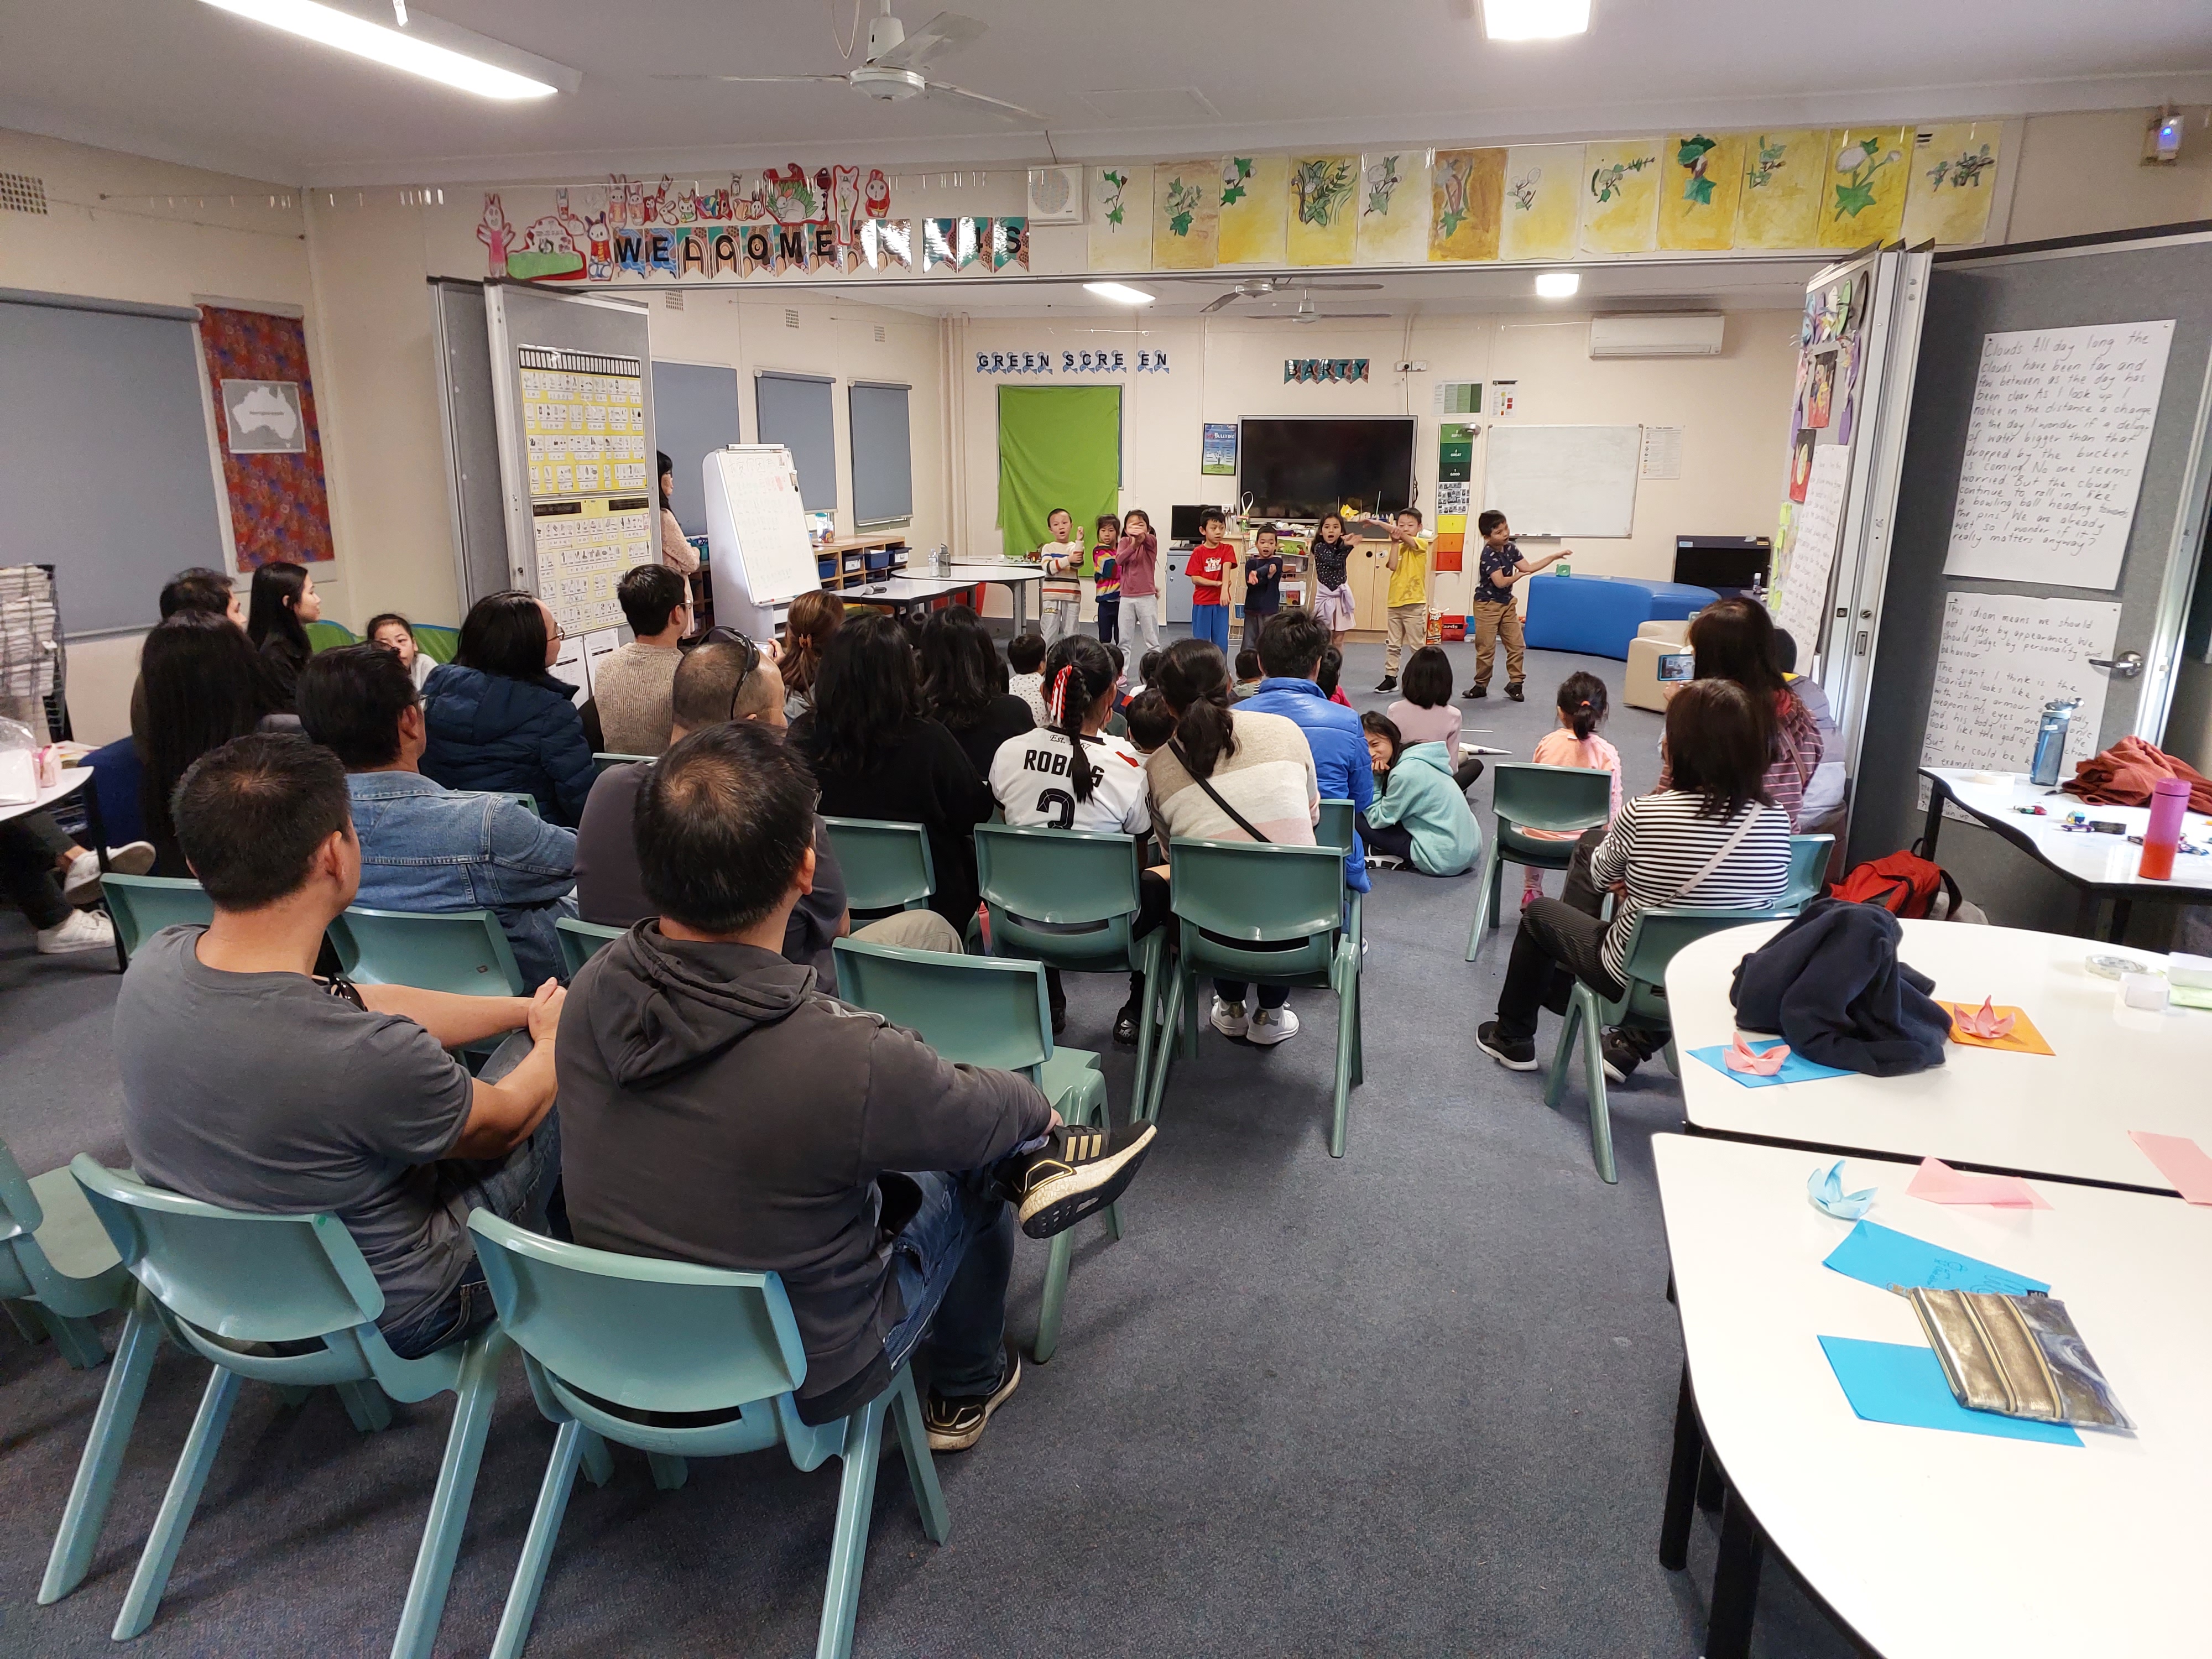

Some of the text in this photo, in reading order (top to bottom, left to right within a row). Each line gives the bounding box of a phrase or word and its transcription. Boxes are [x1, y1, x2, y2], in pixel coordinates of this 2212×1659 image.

[616, 230, 833, 262] WELCOME
[1984, 331, 2150, 362] Clouds All day long the
[979, 355, 1049, 367] GREEN
[1981, 362, 2012, 373] clouds
[2023, 358, 2046, 371] have
[2052, 359, 2081, 371] been
[2117, 358, 2147, 371] and
[2000, 375, 2040, 386] between
[2048, 376, 2060, 384] as
[2068, 374, 2086, 384] the
[2094, 373, 2115, 390] day
[2124, 373, 2146, 383] has
[1975, 389, 2000, 401] been
[2035, 388, 2048, 399] As
[2069, 387, 2090, 399] look
[2098, 392, 2113, 403] up
[1973, 406, 2002, 416] notice
[2007, 408, 2017, 416] in
[2024, 404, 2039, 414] the
[2044, 402, 2092, 414] distance
[1988, 420, 2001, 429] the
[2006, 420, 2025, 437] day
[2038, 419, 2078, 429] wonder
[2083, 417, 2098, 429] if
[2024, 435, 2060, 449] bigger
[2069, 433, 2095, 442] than
[1965, 446, 2008, 462] dropped
[2017, 450, 2031, 466] by
[2043, 449, 2062, 460] the
[2032, 461, 2048, 473] No
[2087, 466, 2132, 477] seems
[1959, 486, 2004, 497] continue
[2035, 488, 2054, 497] roll
[2014, 476, 2040, 487] But
[2048, 477, 2067, 487] the
[2078, 478, 2118, 490] clouds
[1978, 512, 2000, 521] pins
[2012, 508, 2027, 521] We
[2019, 499, 2042, 507] ball
[2049, 500, 2091, 517] heading
[1952, 530, 1982, 548] really
[2057, 526, 2070, 538] if
[1948, 602, 1963, 614] This
[1969, 607, 1996, 620] idiom
[2002, 615, 2030, 624] means
[2058, 617, 2093, 628] should
[1963, 625, 1989, 637] judge
[1997, 625, 2008, 640] by
[2078, 637, 2094, 648] We
[1942, 631, 1969, 642] should
[1973, 637, 1996, 651] judge
[2006, 639, 2016, 653] by
[2024, 642, 2078, 661] personality
[1938, 661, 1953, 672] The
[2058, 680, 2078, 692] the
[1980, 682, 2002, 693] looks
[2012, 686, 2030, 698] like
[1933, 699, 1968, 712] weapons
[1992, 711, 2013, 724] eyes
[1050, 734, 1066, 744] Est.
[1929, 721, 1947, 730] looks
[1980, 730, 1994, 739] the
[1999, 733, 2018, 746] god
[1953, 714, 1966, 724] his
[2074, 738, 2085, 747] He
[1923, 752, 1932, 762] An
[1954, 740, 1965, 752] he
[1972, 749, 1996, 758] could
[2002, 753, 2015, 762] be
